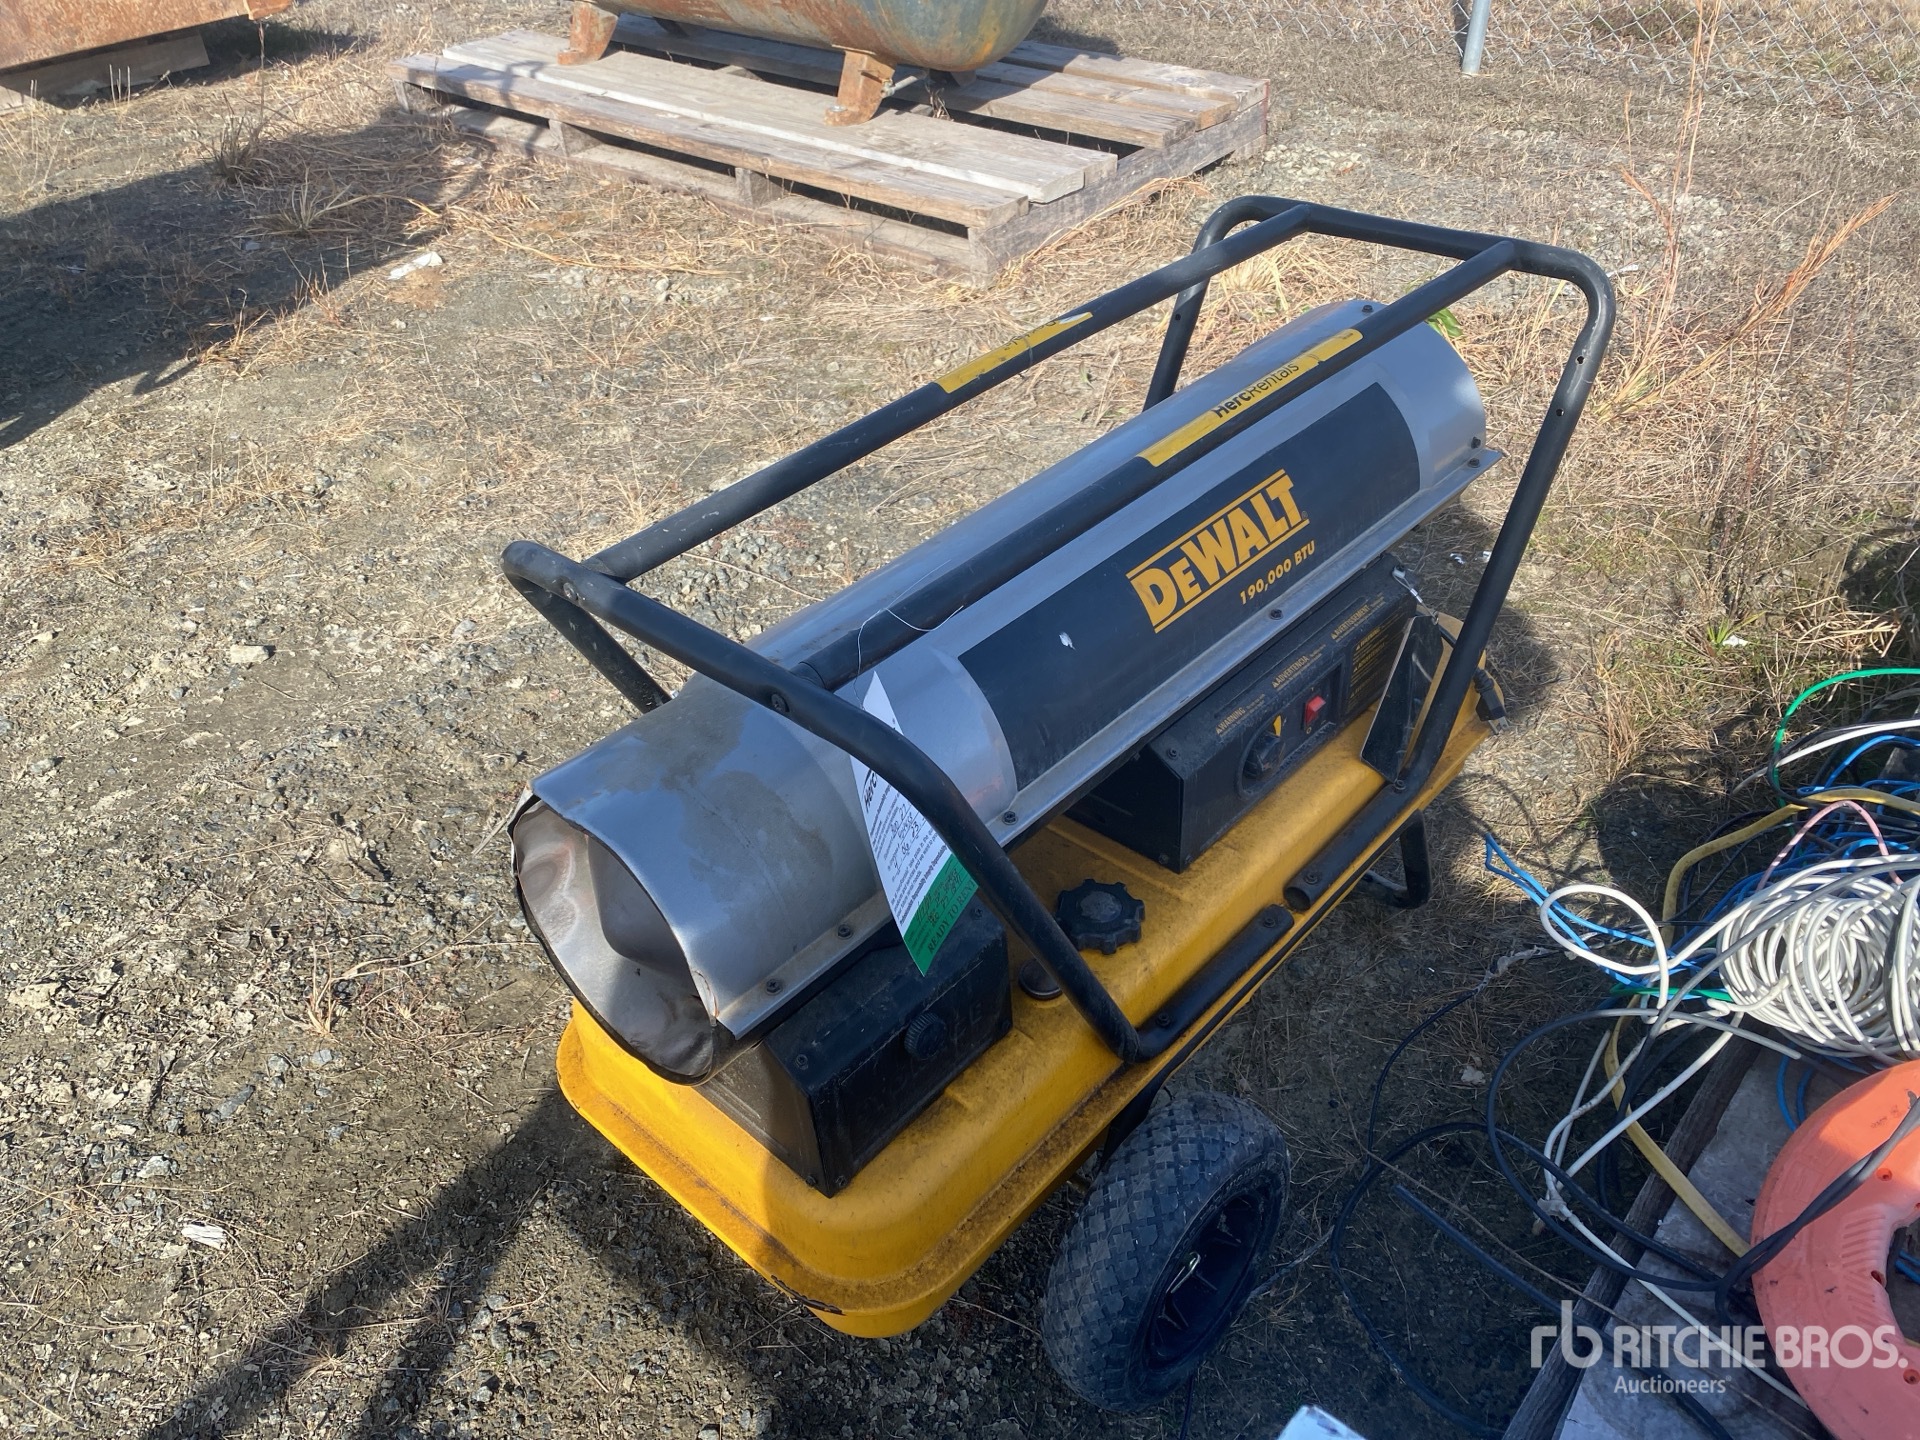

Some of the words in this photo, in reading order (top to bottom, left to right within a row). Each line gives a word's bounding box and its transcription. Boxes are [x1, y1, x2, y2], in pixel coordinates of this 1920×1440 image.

[1213, 359, 1300, 419] HercRentals
[1131, 474, 1303, 628] DEWALT
[1239, 557, 1292, 605] 190,000
[1295, 540, 1316, 568] BTU
[1335, 603, 1371, 636] AVERTISSEMENT
[1276, 655, 1310, 687] ADVERTENCIA
[1219, 706, 1246, 735] WARNING
[927, 916, 949, 953] READY
[947, 902, 958, 918] TO
